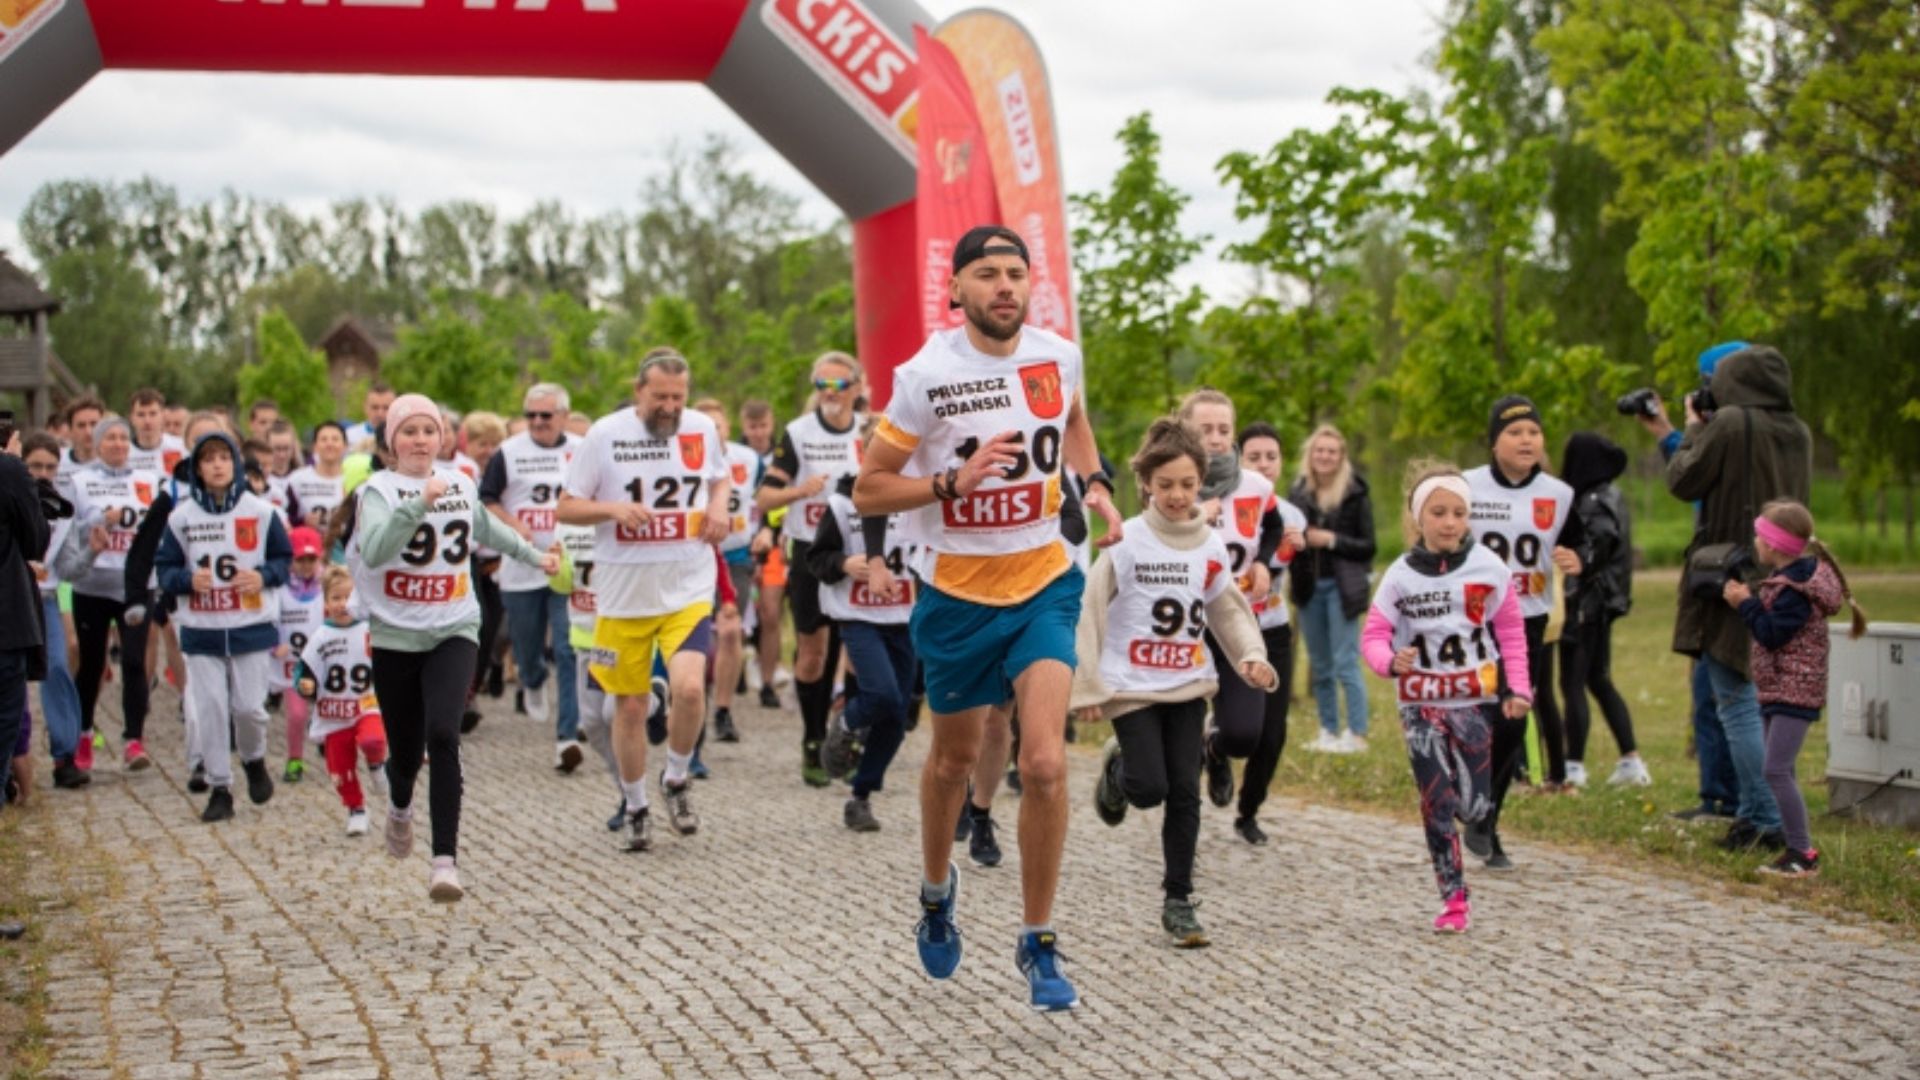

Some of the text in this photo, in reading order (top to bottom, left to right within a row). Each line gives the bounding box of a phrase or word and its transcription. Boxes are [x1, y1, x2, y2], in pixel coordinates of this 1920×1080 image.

[796, 0, 907, 95] CKiS
[926, 377, 1008, 402] PRUSZCZ
[624, 476, 702, 509] 127
[951, 490, 1032, 524] CKiS
[401, 519, 470, 567] 93
[196, 553, 237, 582] 16
[1134, 562, 1190, 574] PRUSZCZ
[1151, 597, 1205, 639] 99
[1409, 627, 1486, 669] 141
[324, 664, 372, 693] 89
[1404, 675, 1473, 699] CKiS
